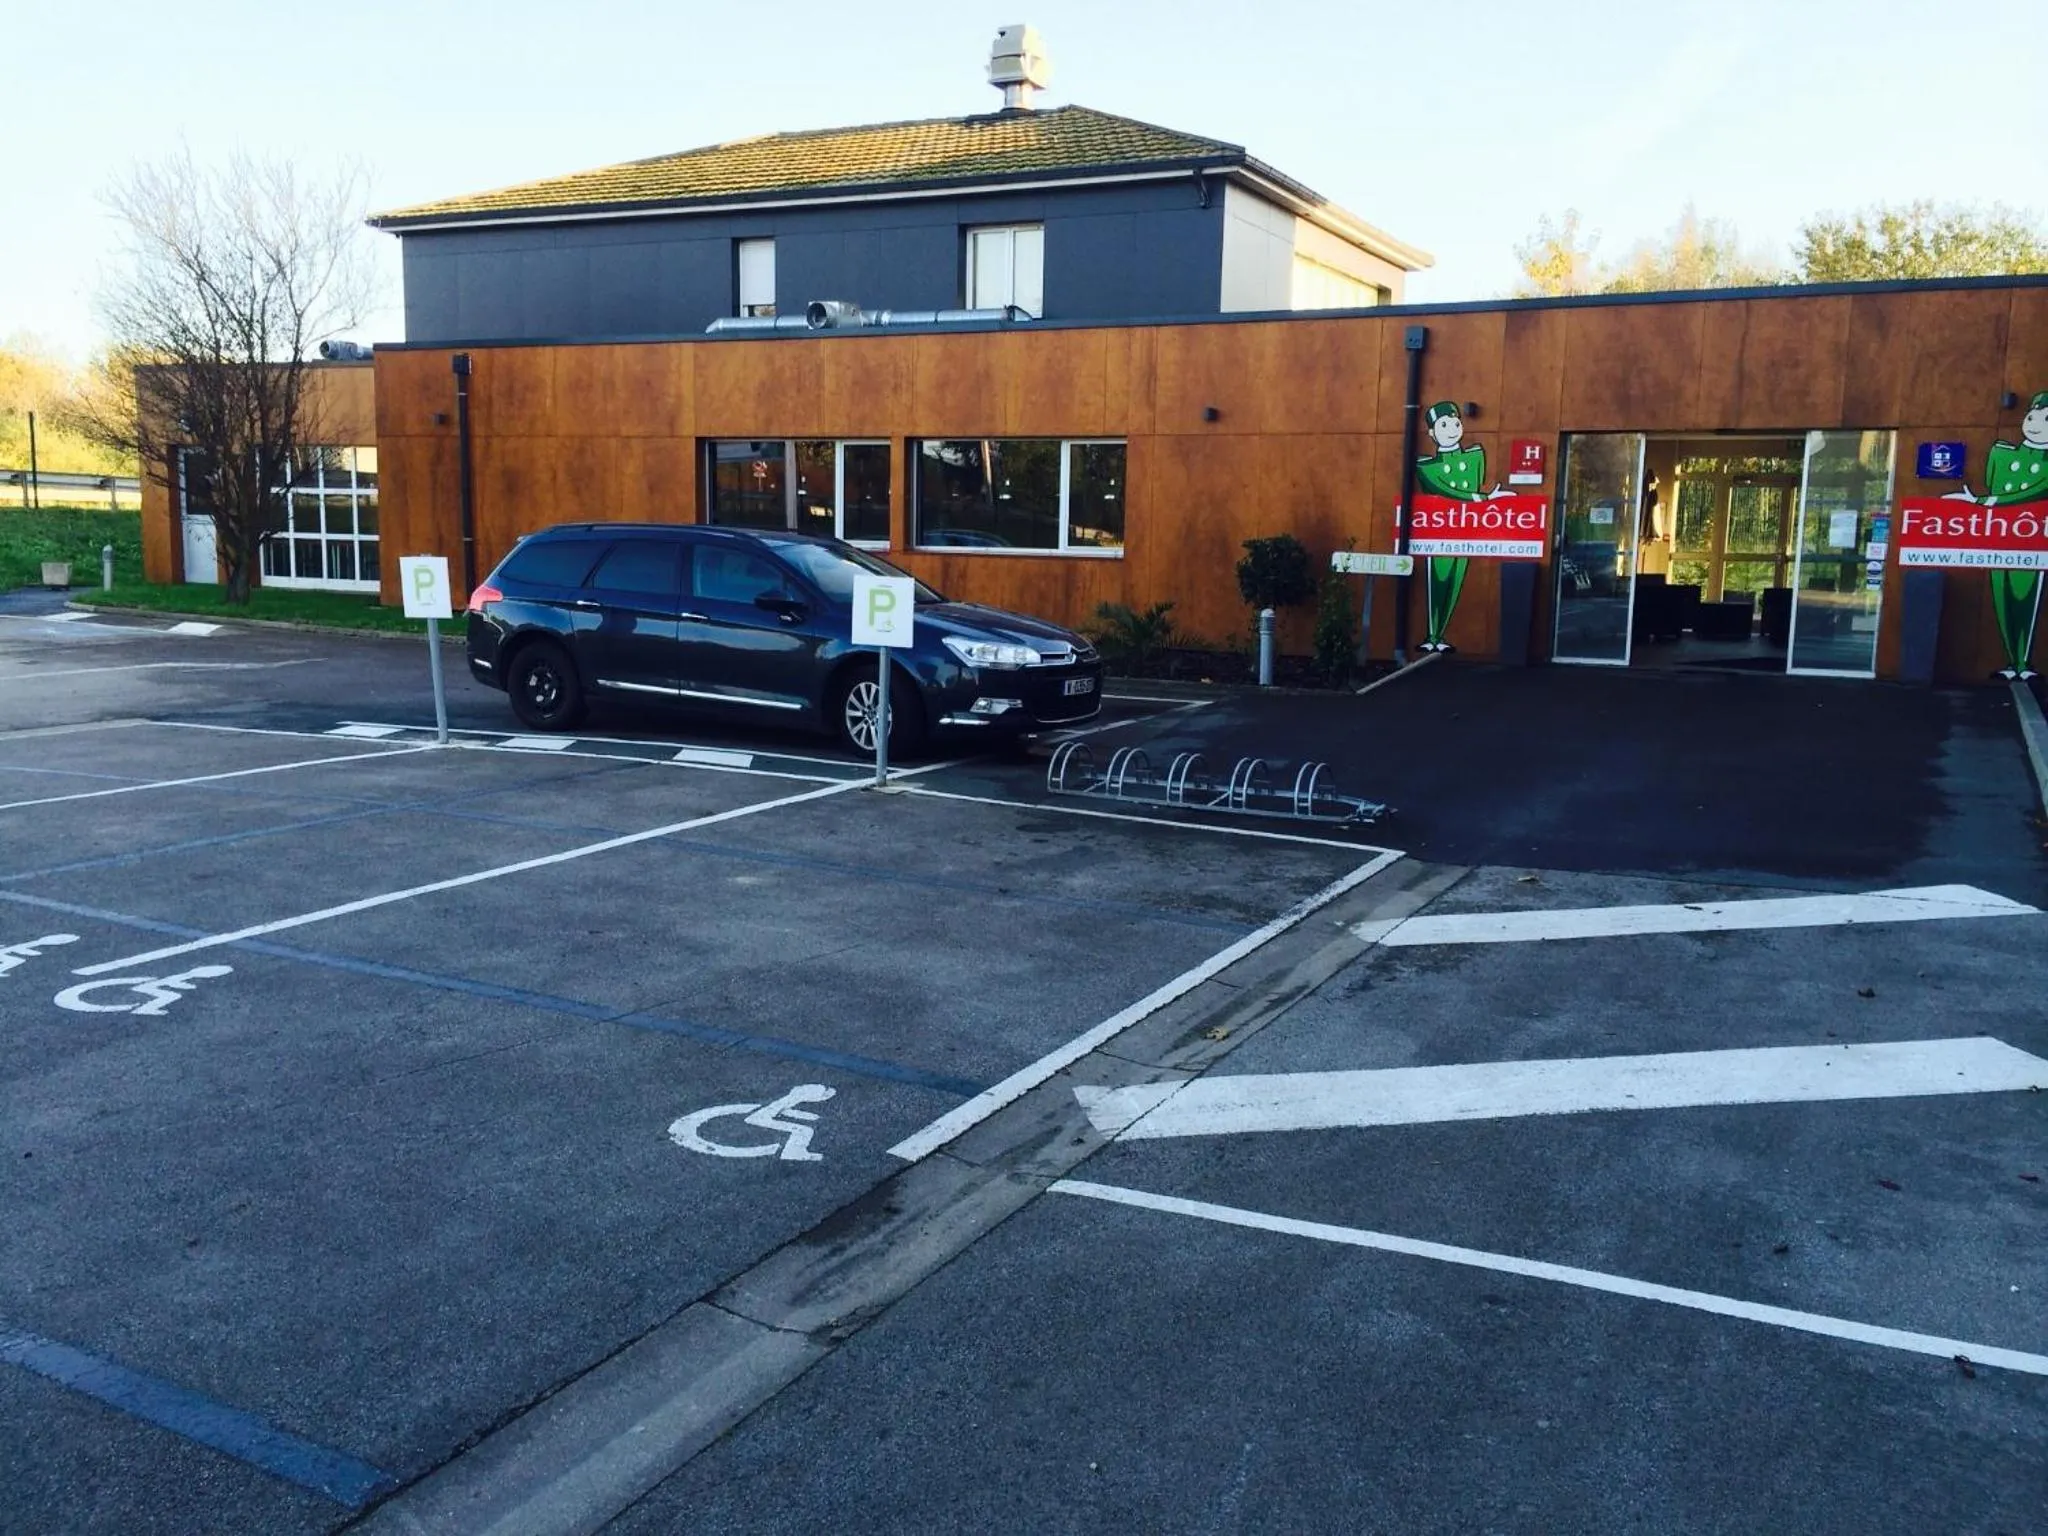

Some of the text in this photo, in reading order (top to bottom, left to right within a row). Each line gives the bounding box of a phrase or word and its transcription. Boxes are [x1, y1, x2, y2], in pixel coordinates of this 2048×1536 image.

[1525, 446, 1540, 459] H
[1411, 541, 1538, 555] ww.fasthotel.com
[413, 568, 434, 600] P
[869, 589, 896, 627] P
